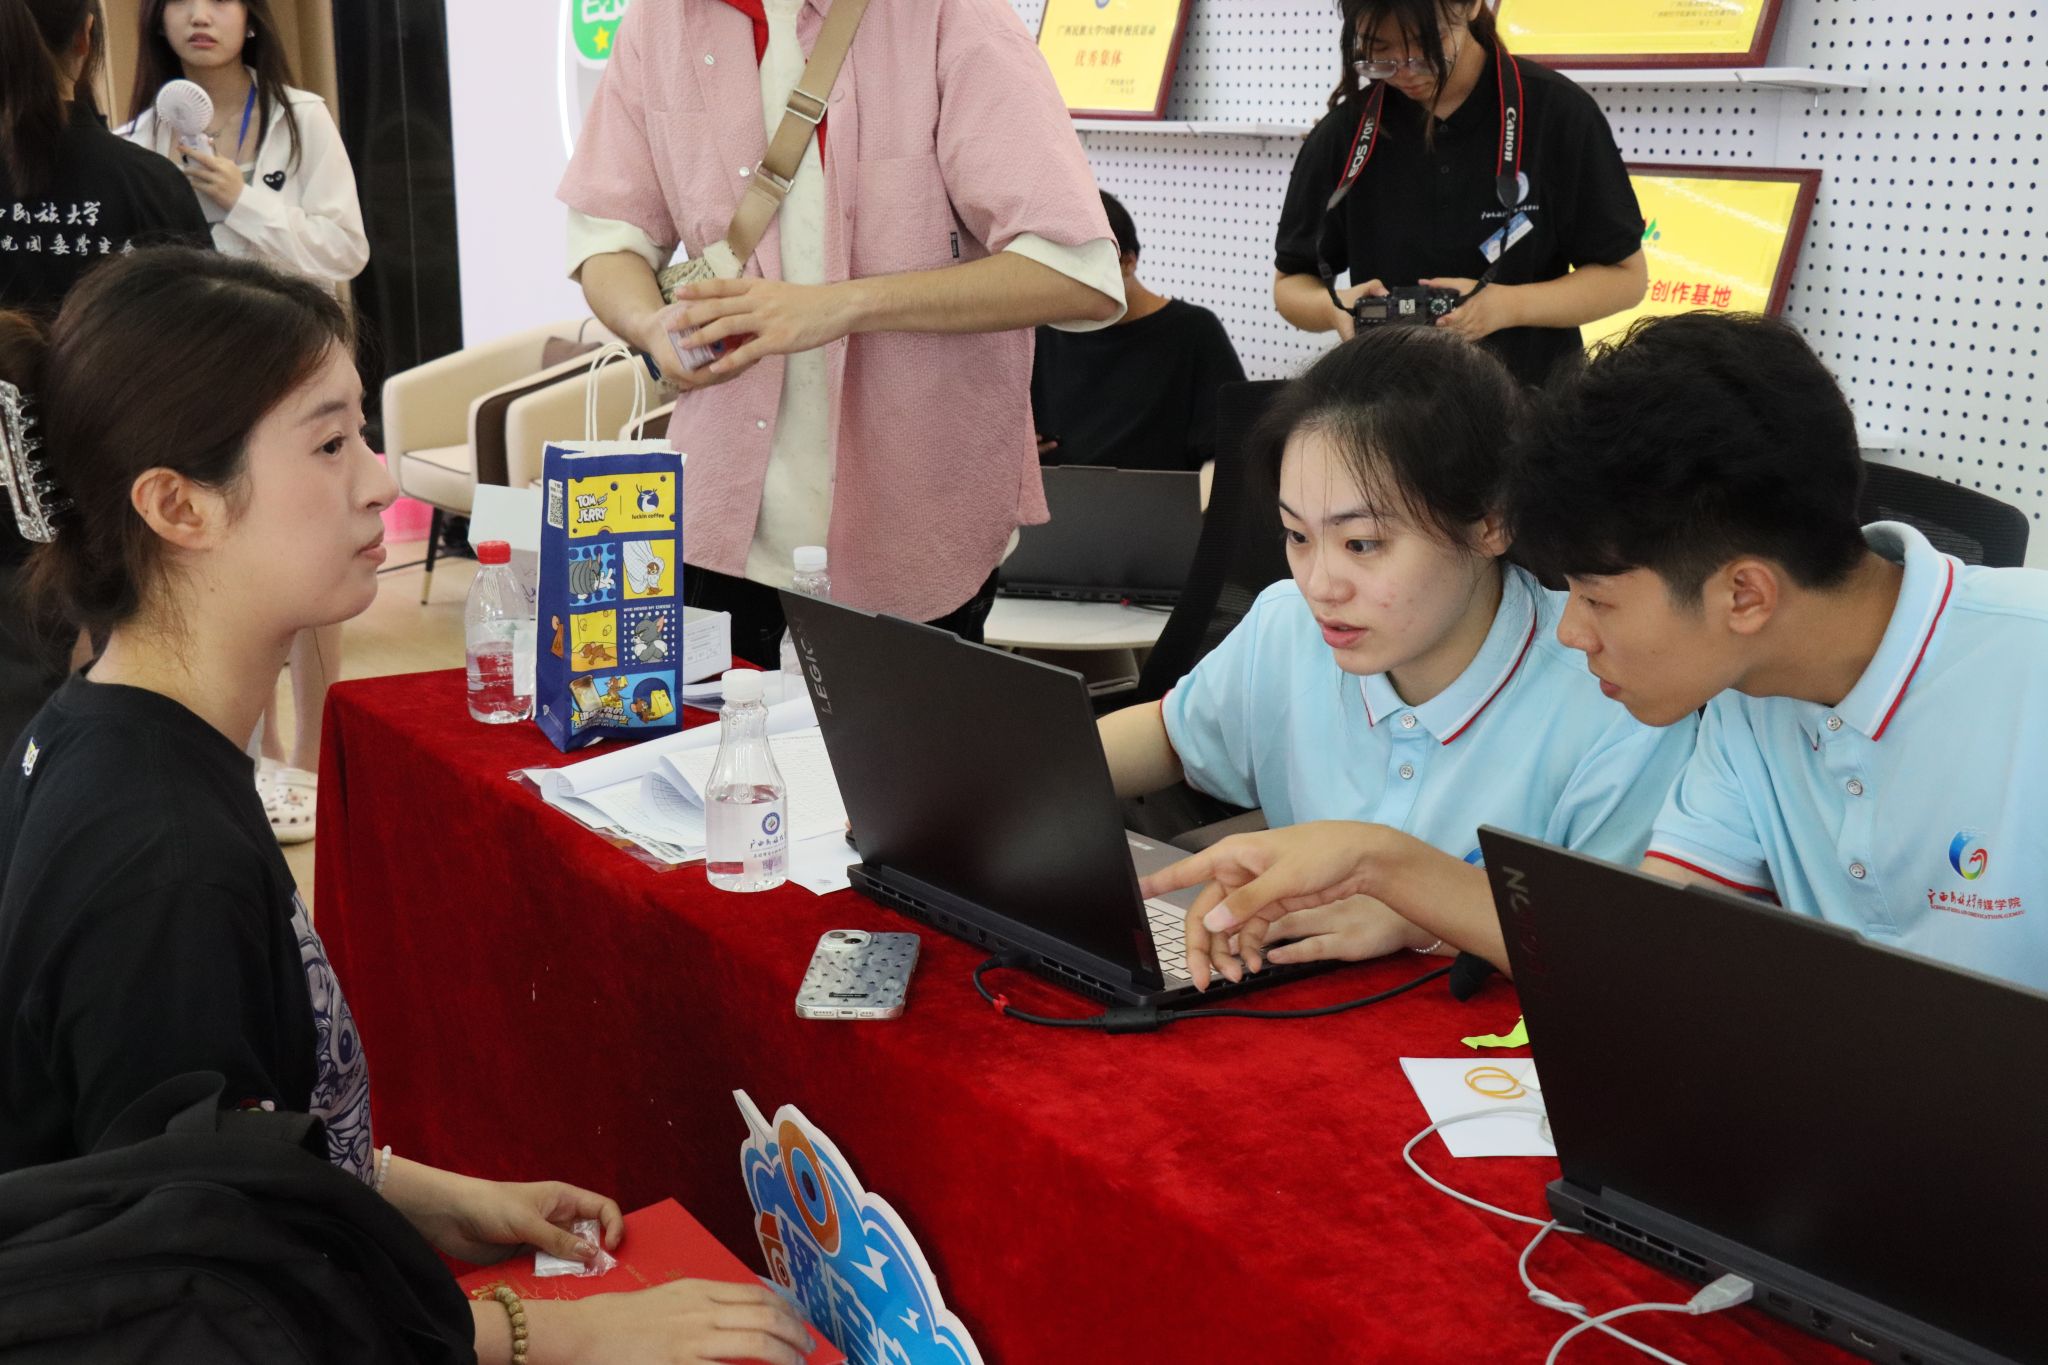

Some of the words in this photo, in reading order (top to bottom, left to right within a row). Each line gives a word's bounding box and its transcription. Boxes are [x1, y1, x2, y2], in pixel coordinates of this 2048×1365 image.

[1074, 49, 1122, 67] 优秀集体
[1504, 106, 1517, 162] Canon
[1348, 144, 1369, 178] EOS
[1648, 280, 1732, 308] 创作基地
[576, 494, 597, 508] TOM
[577, 507, 608, 523] JERRY
